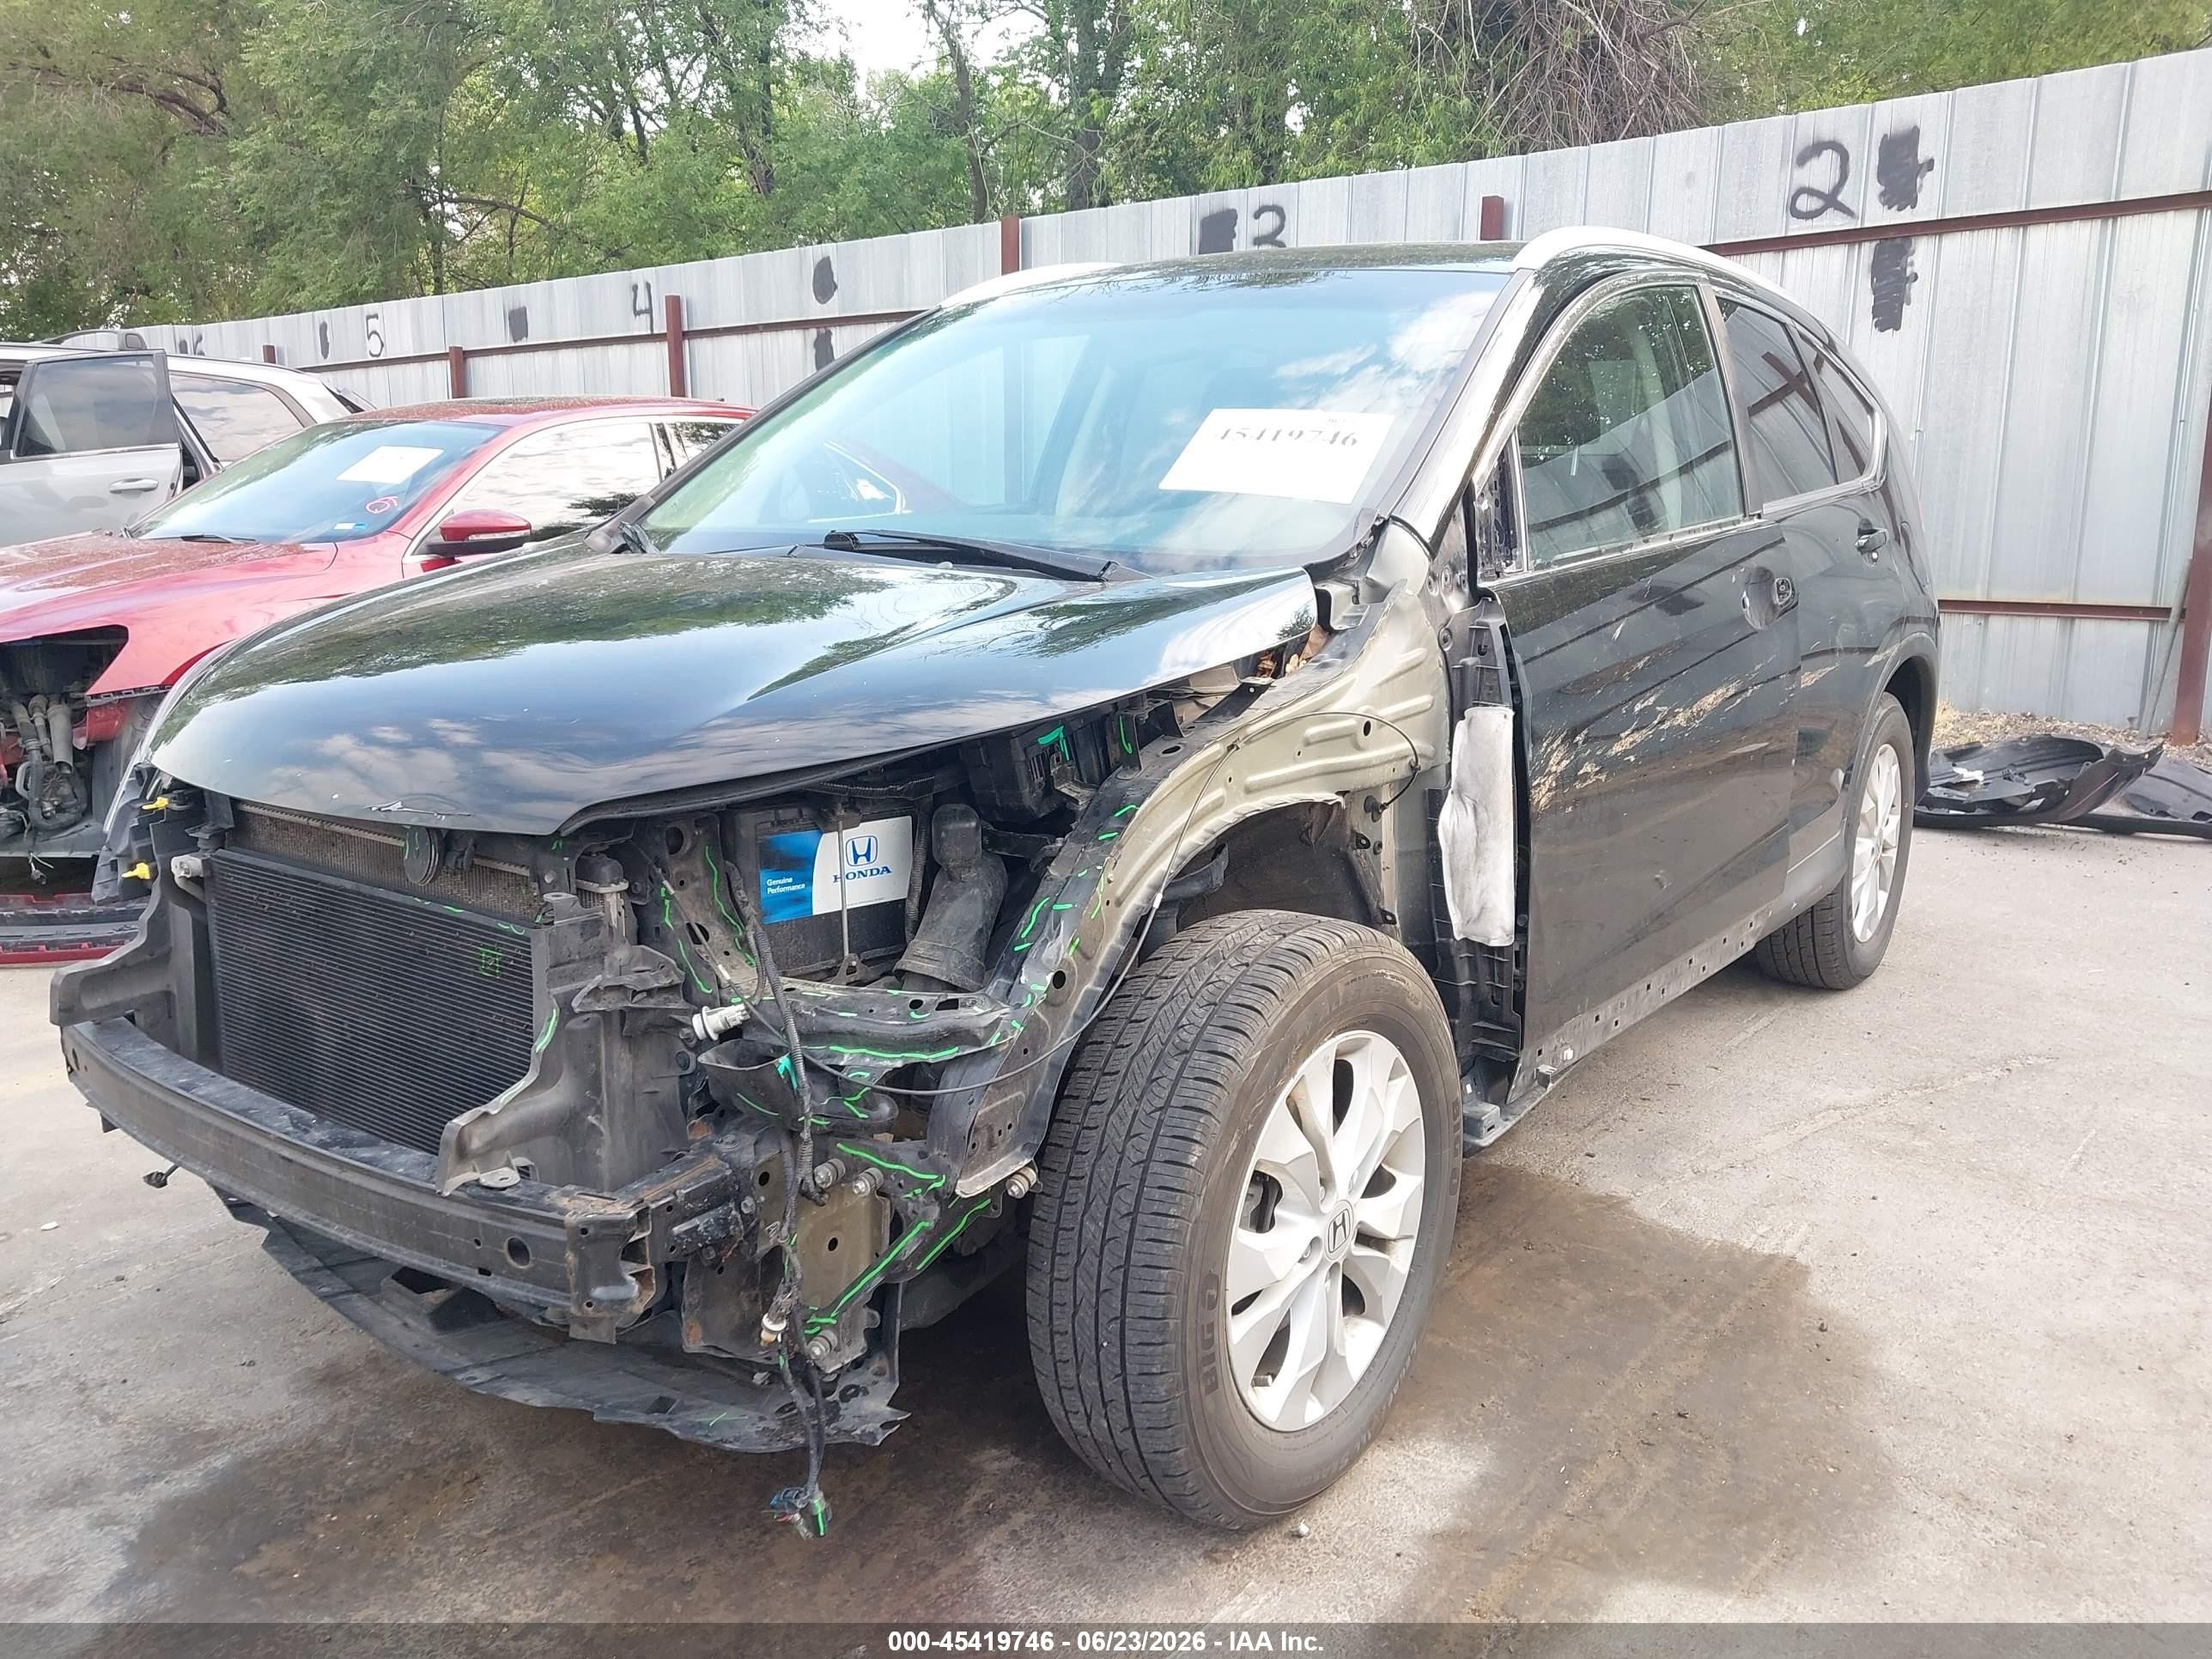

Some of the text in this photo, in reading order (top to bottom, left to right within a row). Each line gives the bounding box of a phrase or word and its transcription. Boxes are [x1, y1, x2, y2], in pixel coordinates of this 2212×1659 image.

[1790, 141, 1857, 220] 2
[632, 281, 653, 334] 4
[366, 313, 384, 358] 5
[766, 877, 793, 886] Genuine
[767, 884, 805, 895] Performance
[832, 866, 893, 884] HONDA
